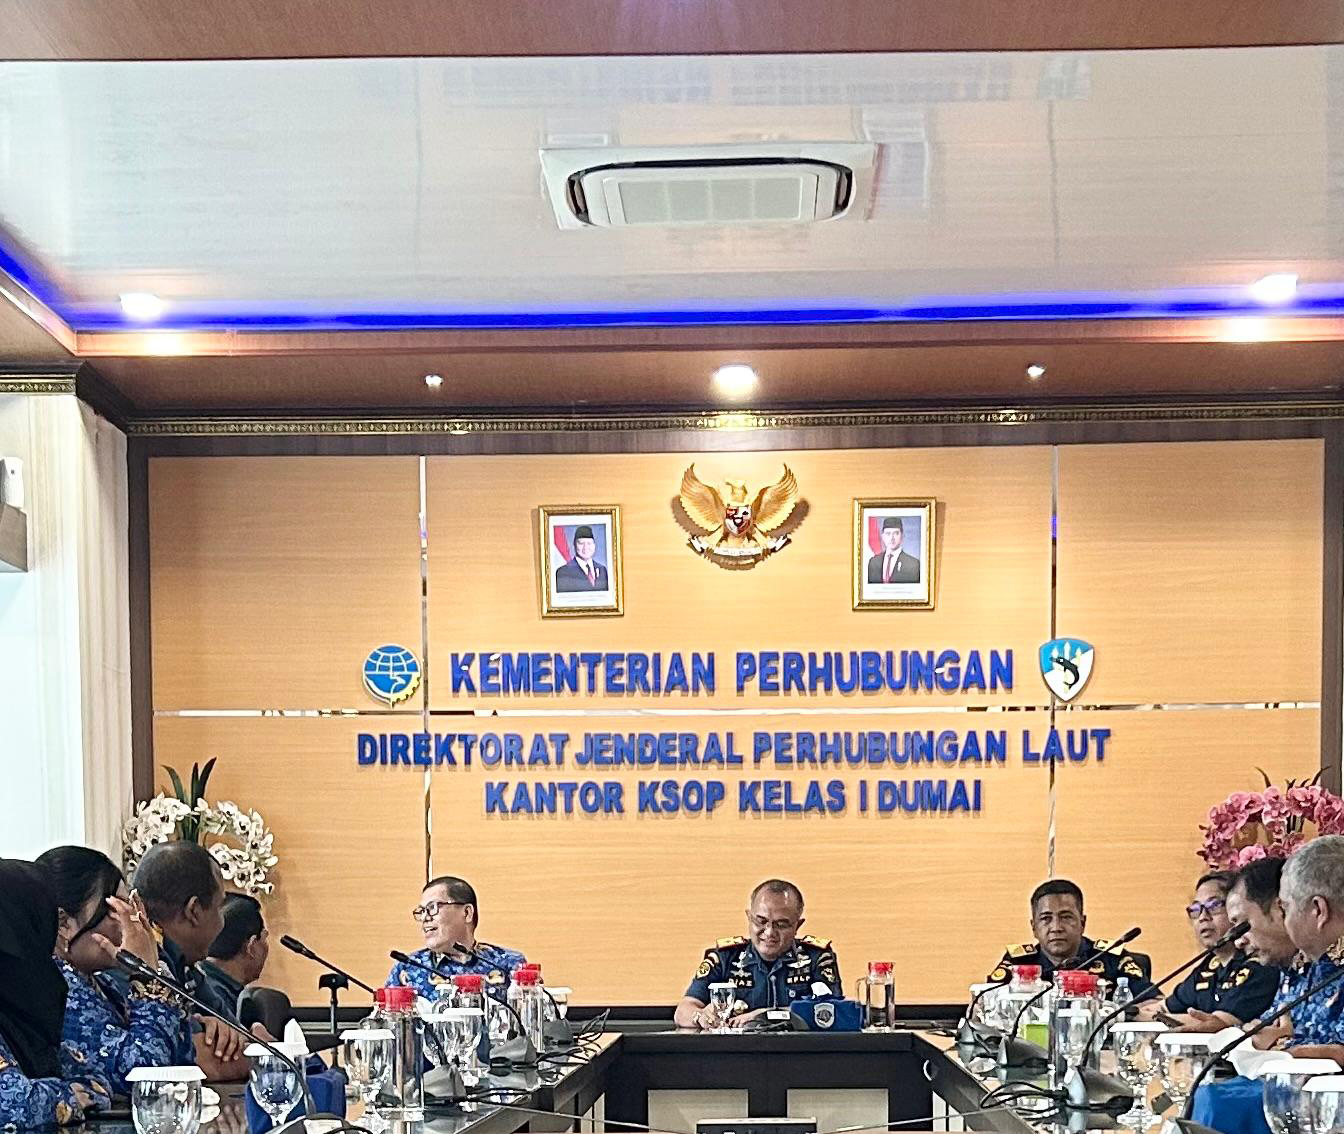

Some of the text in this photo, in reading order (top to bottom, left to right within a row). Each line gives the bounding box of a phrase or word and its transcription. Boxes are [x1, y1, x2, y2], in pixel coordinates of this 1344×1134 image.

[451, 649, 1013, 693] KEMENTERIAN PERHUBUNGAN
[358, 729, 1110, 765] DIREKTORAT JENDERAL PERHUBUNGAN LAUT
[485, 779, 981, 813] KANTOR KSOP KELAS I DUMAI
